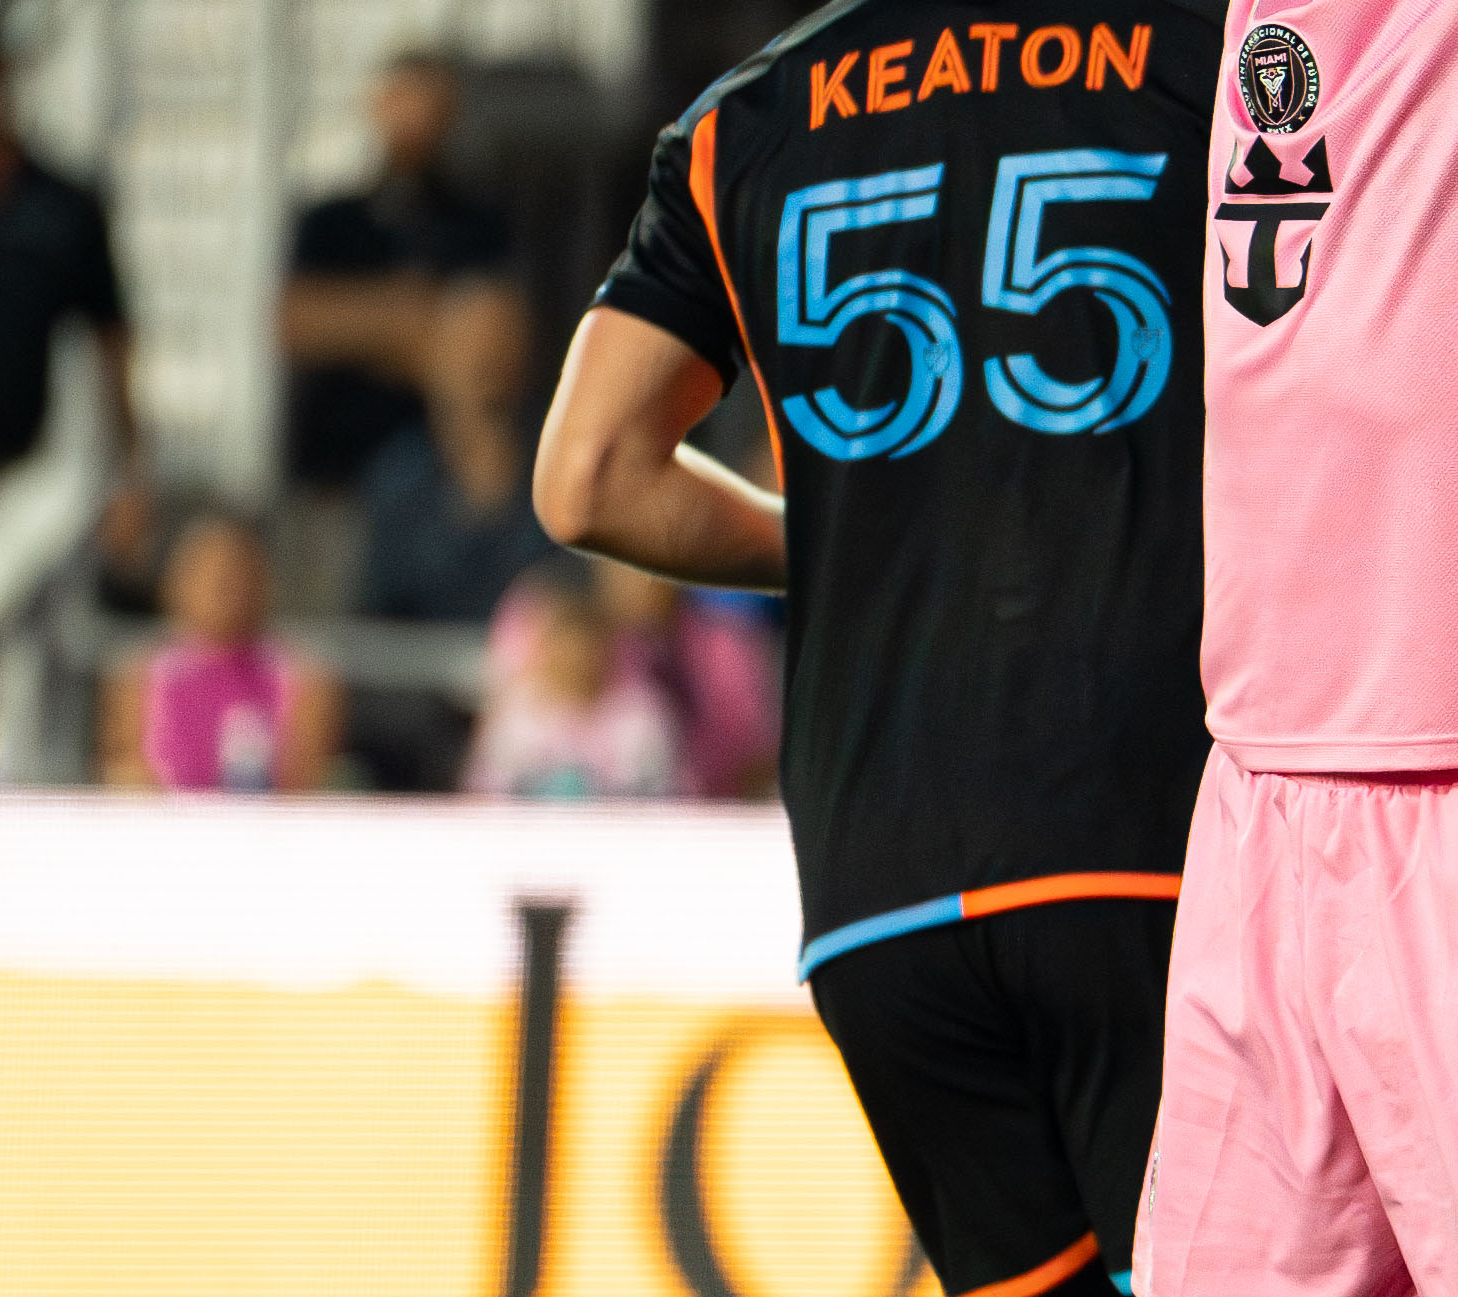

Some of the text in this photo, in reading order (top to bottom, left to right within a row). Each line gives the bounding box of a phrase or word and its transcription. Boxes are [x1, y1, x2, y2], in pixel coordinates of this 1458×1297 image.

[809, 22, 1152, 131] KEATON
[1254, 52, 1288, 67] MIAMI
[776, 147, 1173, 461] 55
